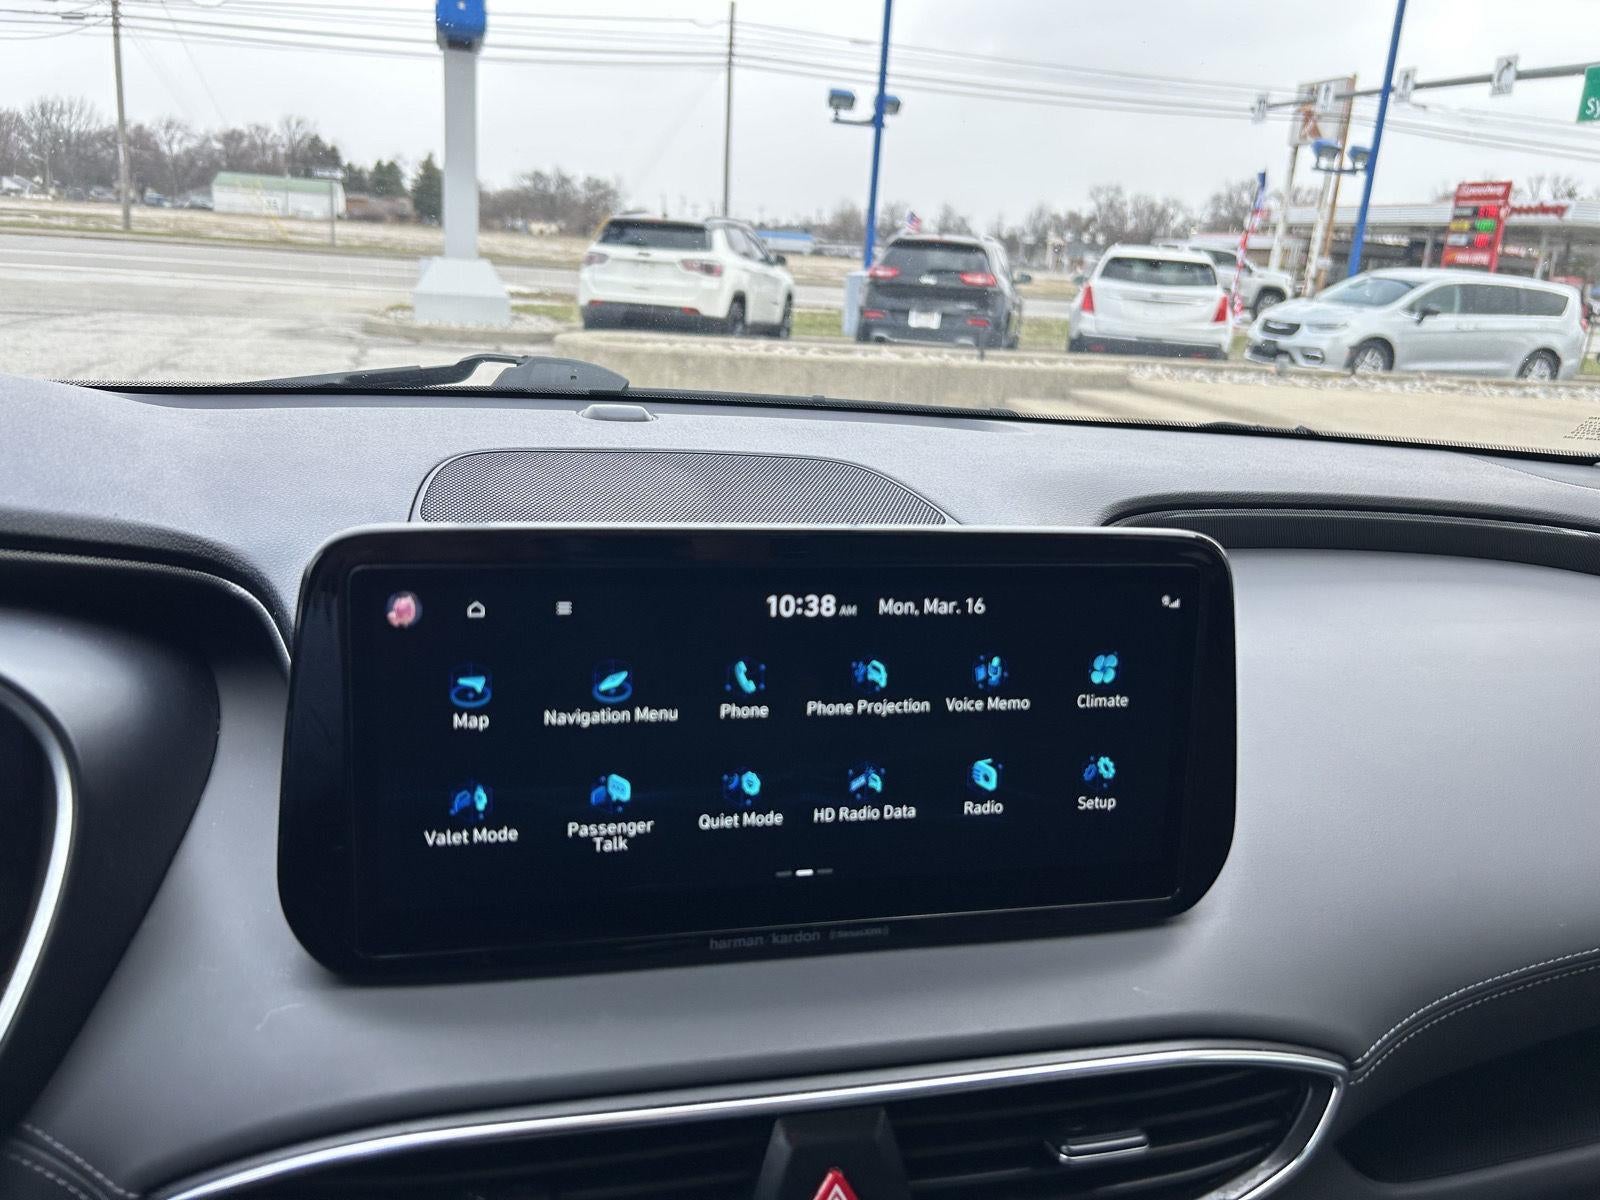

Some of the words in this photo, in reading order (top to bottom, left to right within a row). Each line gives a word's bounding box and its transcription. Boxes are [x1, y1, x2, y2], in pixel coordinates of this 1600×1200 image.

[766, 594, 837, 618] 10:38
[839, 604, 858, 616] AM
[878, 598, 920, 616] Mon,
[923, 598, 962, 615] Mar.
[965, 597, 987, 614] 16
[719, 703, 770, 719] Phone
[806, 700, 854, 717] Phone
[856, 698, 931, 717] Projection
[945, 697, 984, 712] Voice
[986, 696, 1031, 711] Memo
[1076, 694, 1130, 709] Climate
[452, 712, 490, 732] Map
[543, 702, 631, 728] Navigation
[633, 705, 679, 723] Menu
[813, 807, 836, 824] HD
[838, 805, 881, 822] Radio
[882, 804, 917, 820] Data
[963, 800, 1004, 816] Radio
[1077, 796, 1117, 813] Setup
[567, 819, 655, 839] Passenger
[698, 813, 740, 830] Quiet
[742, 810, 784, 828] Mode
[424, 829, 470, 847] Valet
[472, 825, 519, 844] Mode
[591, 836, 629, 853] Talk
[708, 934, 765, 950] harman
[771, 930, 821, 945] kardon
